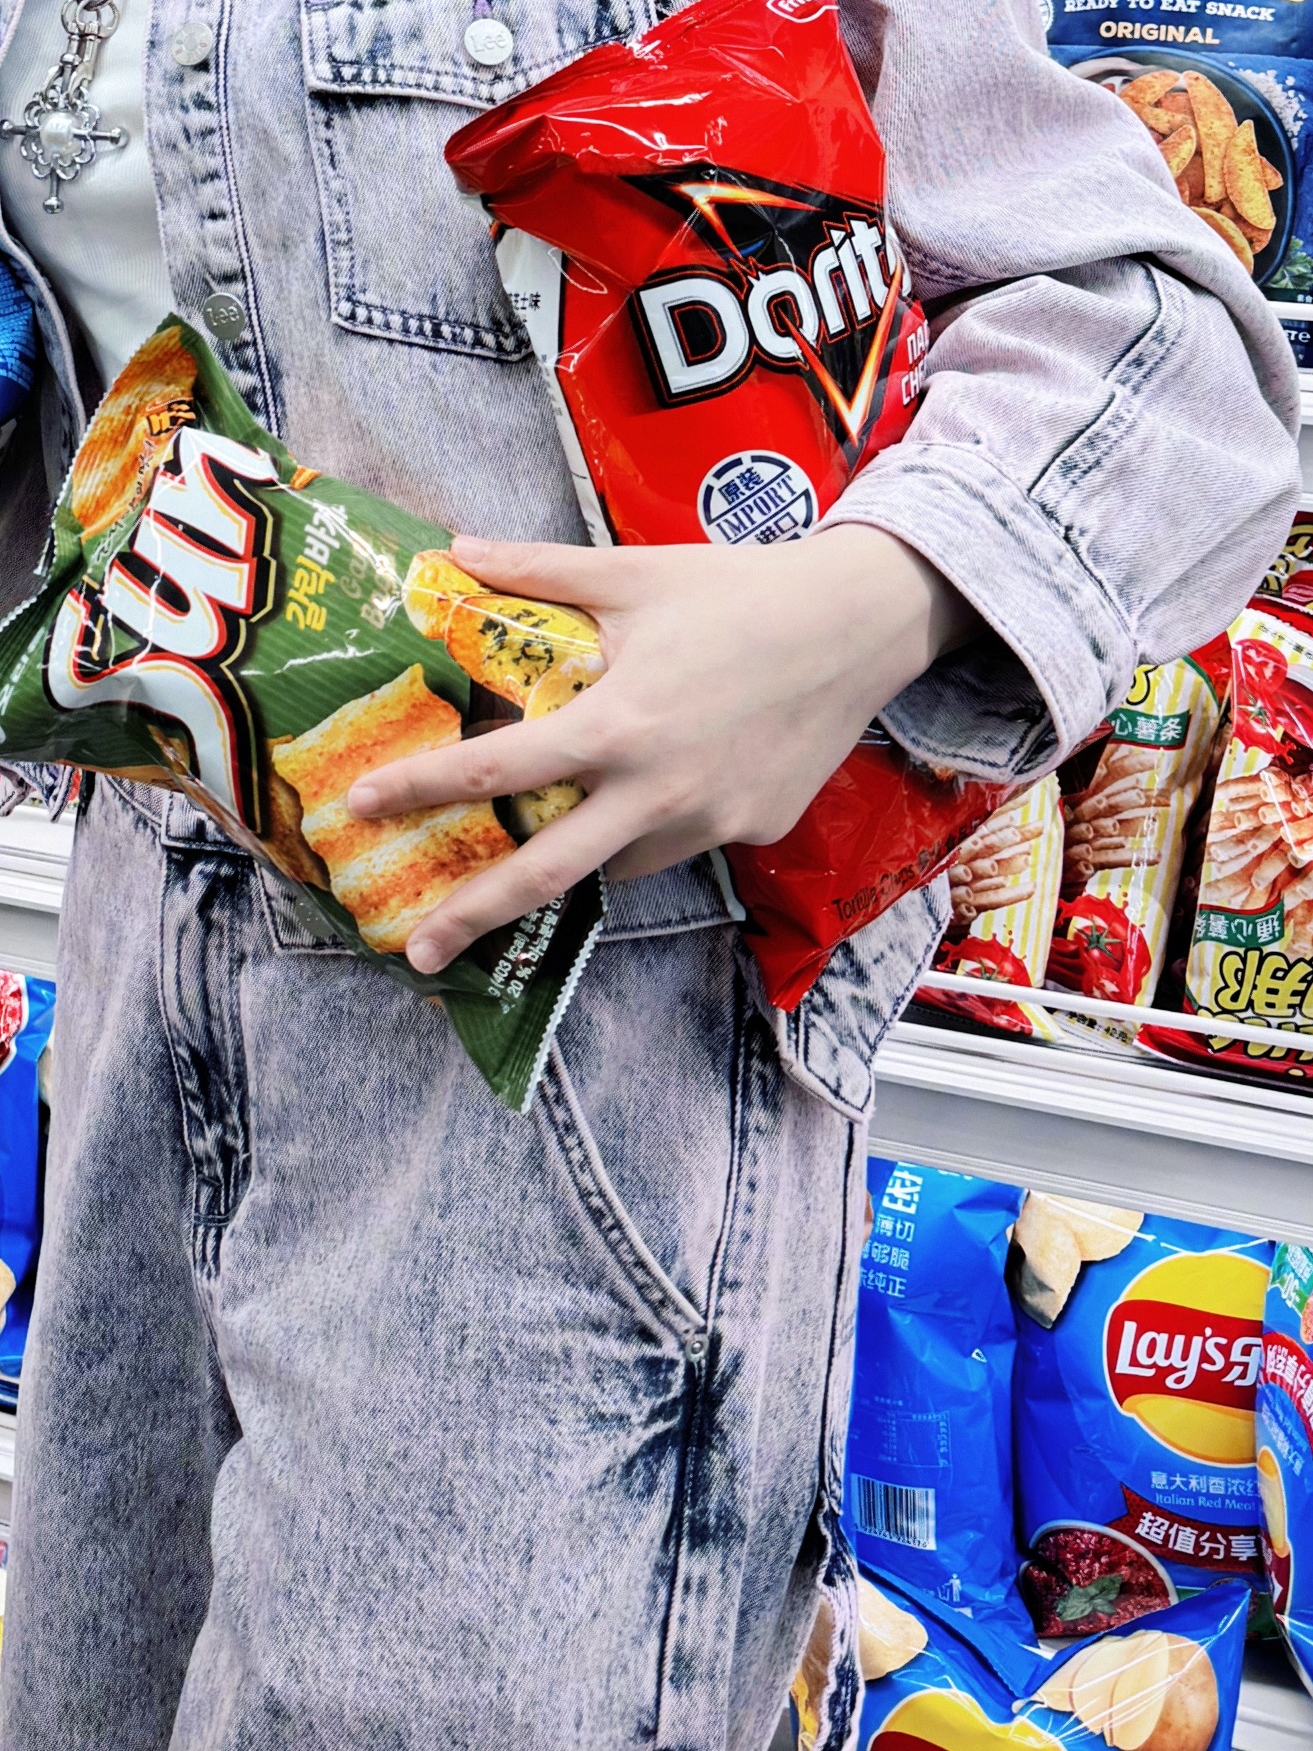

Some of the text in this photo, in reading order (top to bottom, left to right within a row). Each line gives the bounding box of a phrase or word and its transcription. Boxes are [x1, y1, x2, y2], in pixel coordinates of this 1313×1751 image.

[1098, 19, 1221, 46] ORIGINAL
[1205, 3, 1276, 22] SNACK
[638, 216, 912, 397] Dorit
[715, 473, 798, 543] IMPORT
[285, 499, 349, 631] 갈릭바게
[1111, 710, 1189, 742] 心薯条
[1116, 1322, 1264, 1389] Lay's乐
[1150, 1469, 1260, 1499] 意大利香浓红
[1154, 1492, 1196, 1508] Italian
[1198, 1494, 1222, 1509] Red
[1135, 1511, 1263, 1559] 超值分享
